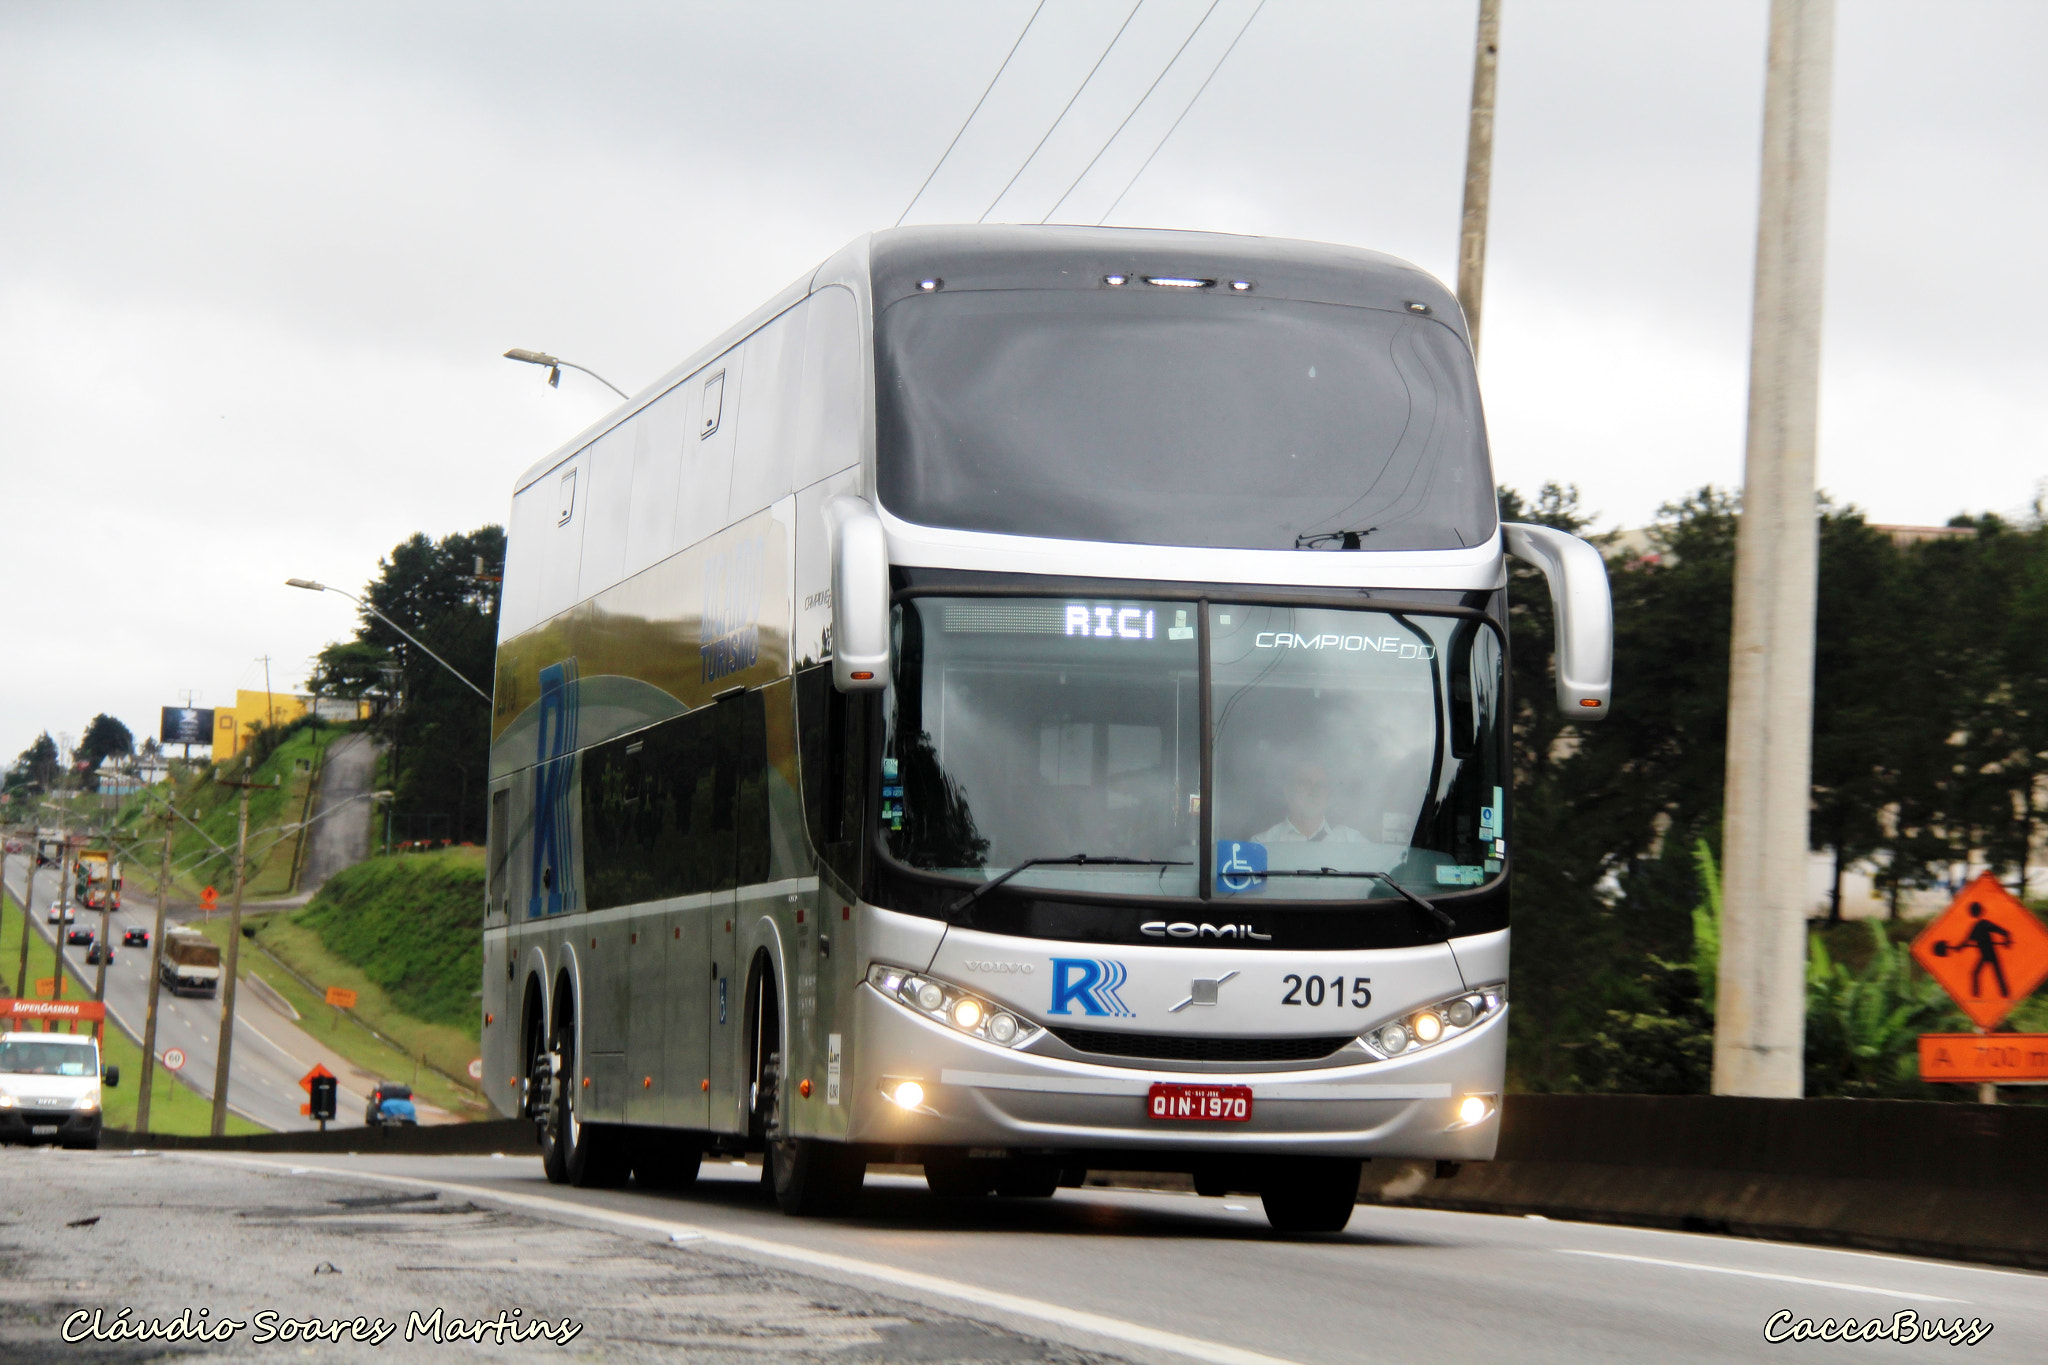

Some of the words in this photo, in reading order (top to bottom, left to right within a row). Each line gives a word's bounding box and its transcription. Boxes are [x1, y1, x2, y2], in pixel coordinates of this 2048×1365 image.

[701, 622, 759, 685] TURISMO
[1140, 921, 1272, 941] COMIL
[963, 960, 1035, 975] VOLVO
[1281, 974, 1372, 1009] 2015
